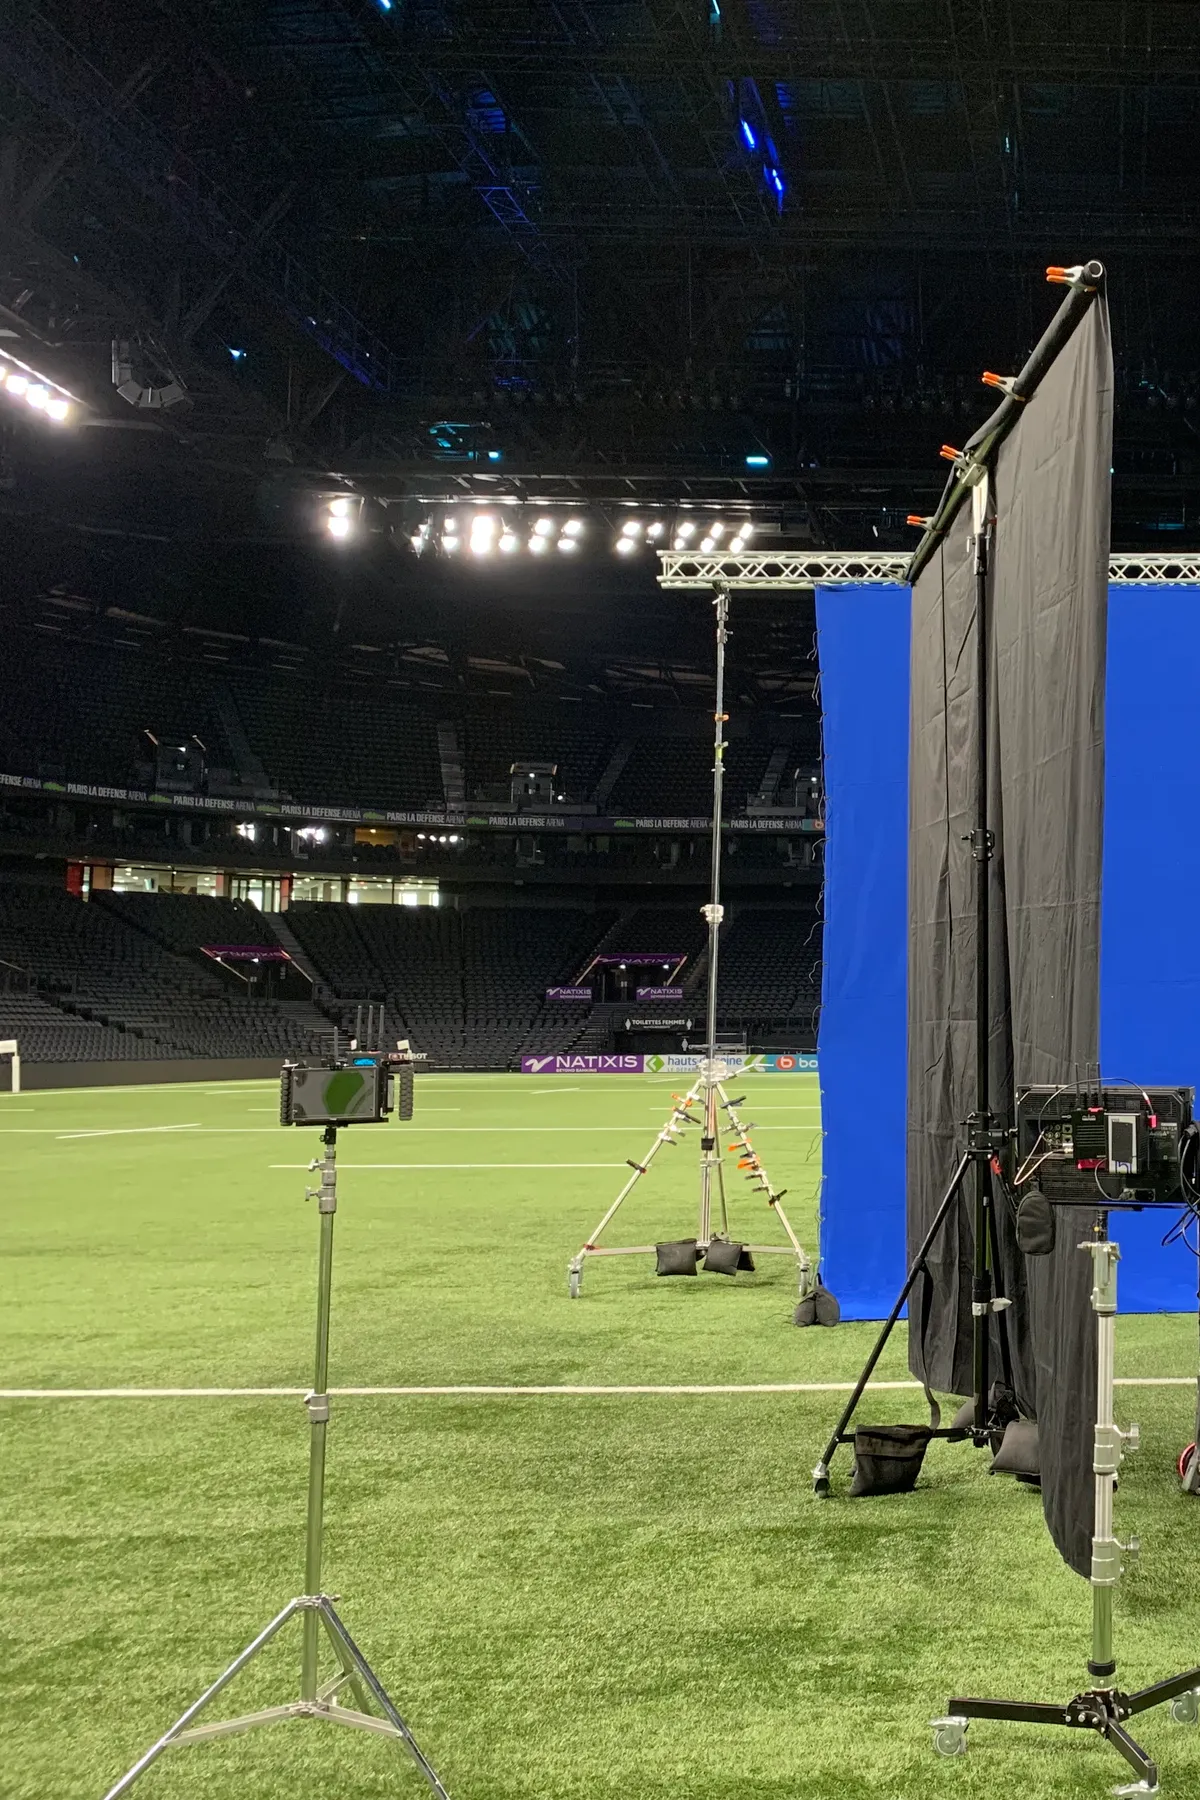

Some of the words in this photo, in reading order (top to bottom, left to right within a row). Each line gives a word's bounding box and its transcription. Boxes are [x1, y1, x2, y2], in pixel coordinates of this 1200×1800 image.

[88, 786, 98, 796] LA
[194, 797, 204, 807] LA
[302, 806, 312, 816] LA
[407, 813, 416, 823] LA
[509, 817, 518, 826] LA
[654, 820, 662, 828] LA
[749, 820, 757, 828] LA
[556, 1056, 638, 1068] NATIXIS
